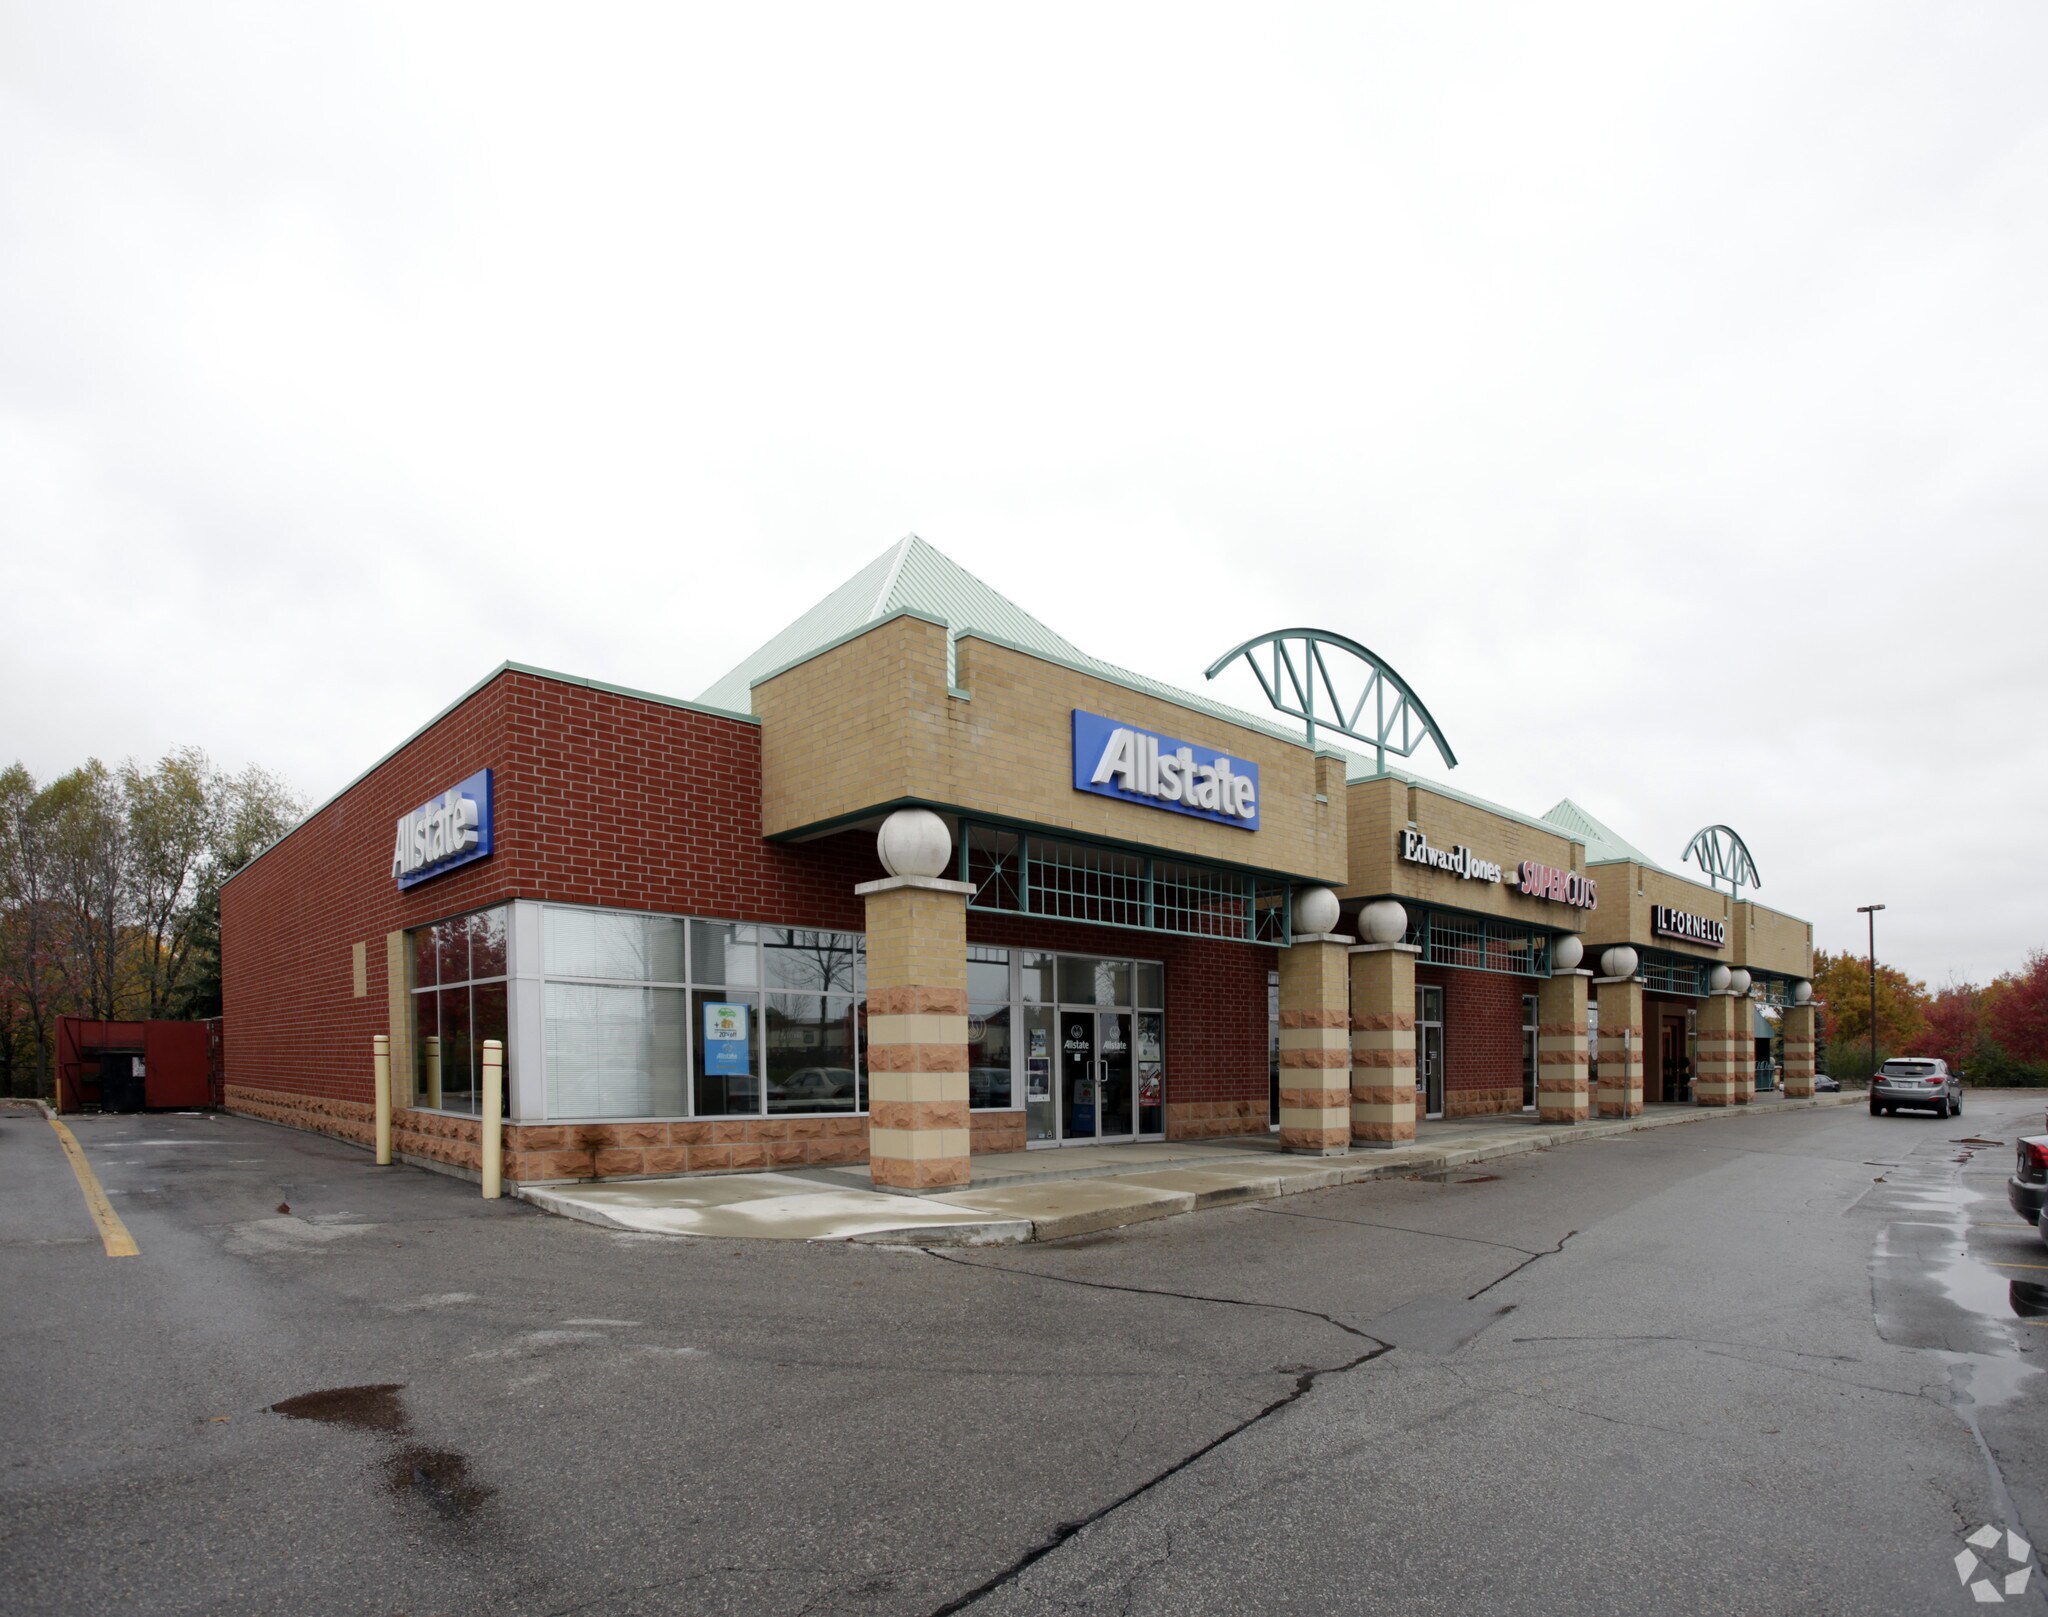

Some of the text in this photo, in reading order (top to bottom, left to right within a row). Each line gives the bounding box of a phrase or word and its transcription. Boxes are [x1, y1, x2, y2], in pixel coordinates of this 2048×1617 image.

[1091, 728, 1255, 818] Allstate
[391, 789, 479, 879] Allstate
[1401, 829, 1501, 884] Edward Jones
[1521, 860, 1598, 910] SUPERCUTS
[1657, 905, 1725, 943] IL FORNELLO
[1064, 1040, 1089, 1049] Allstate
[1102, 1041, 1127, 1050] Allstate
